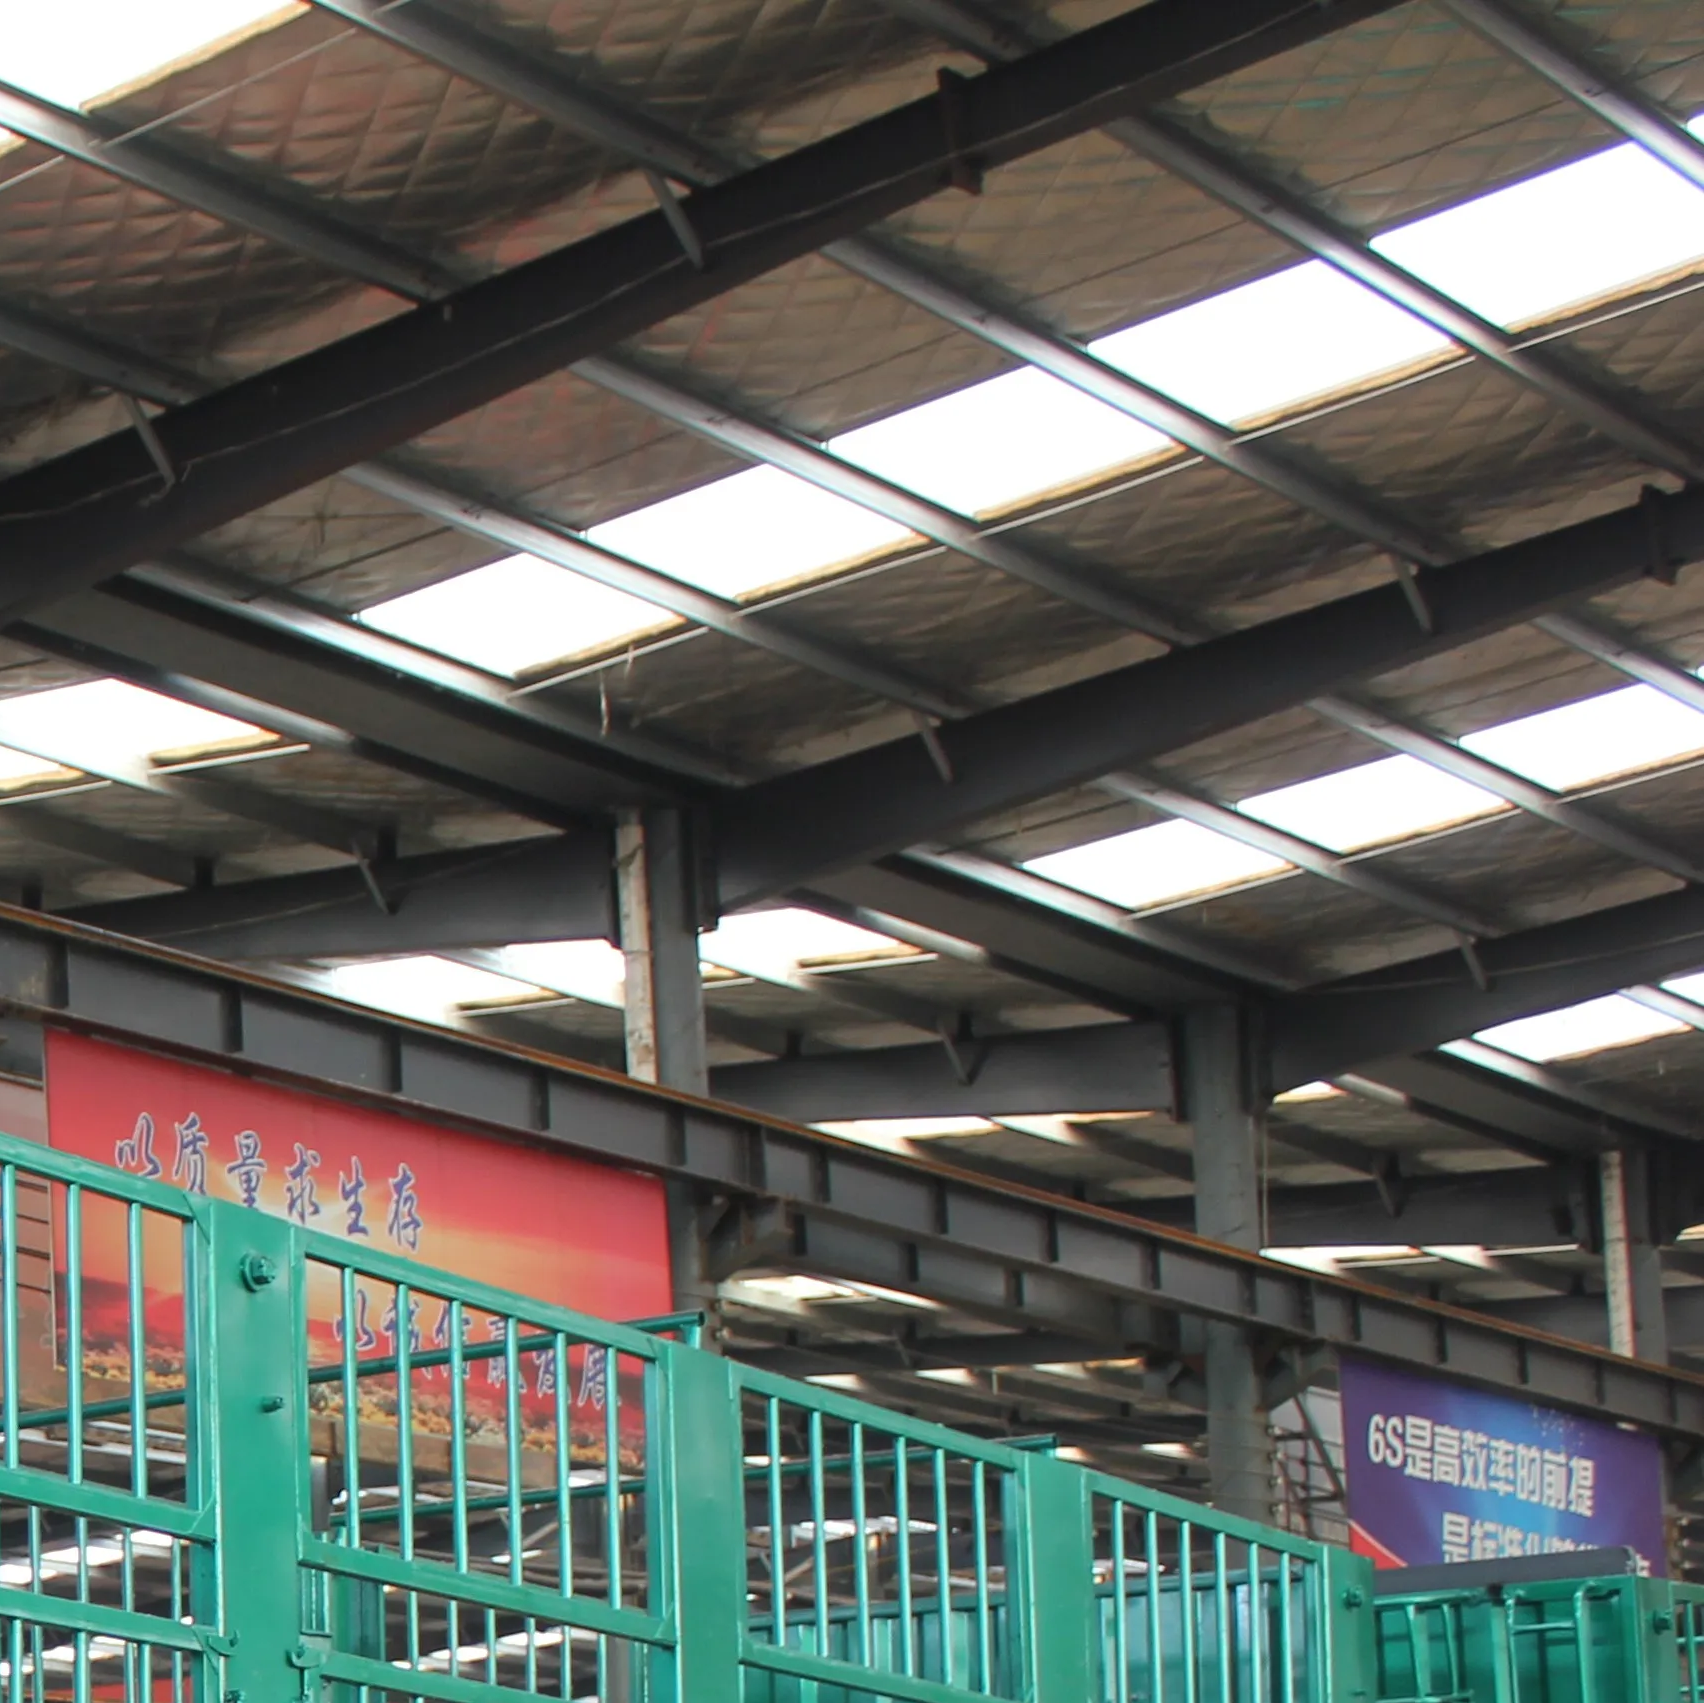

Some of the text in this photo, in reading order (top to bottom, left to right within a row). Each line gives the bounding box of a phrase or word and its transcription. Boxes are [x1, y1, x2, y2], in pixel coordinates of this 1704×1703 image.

[1367, 1413, 1595, 1518] 6S是高效率的前提
